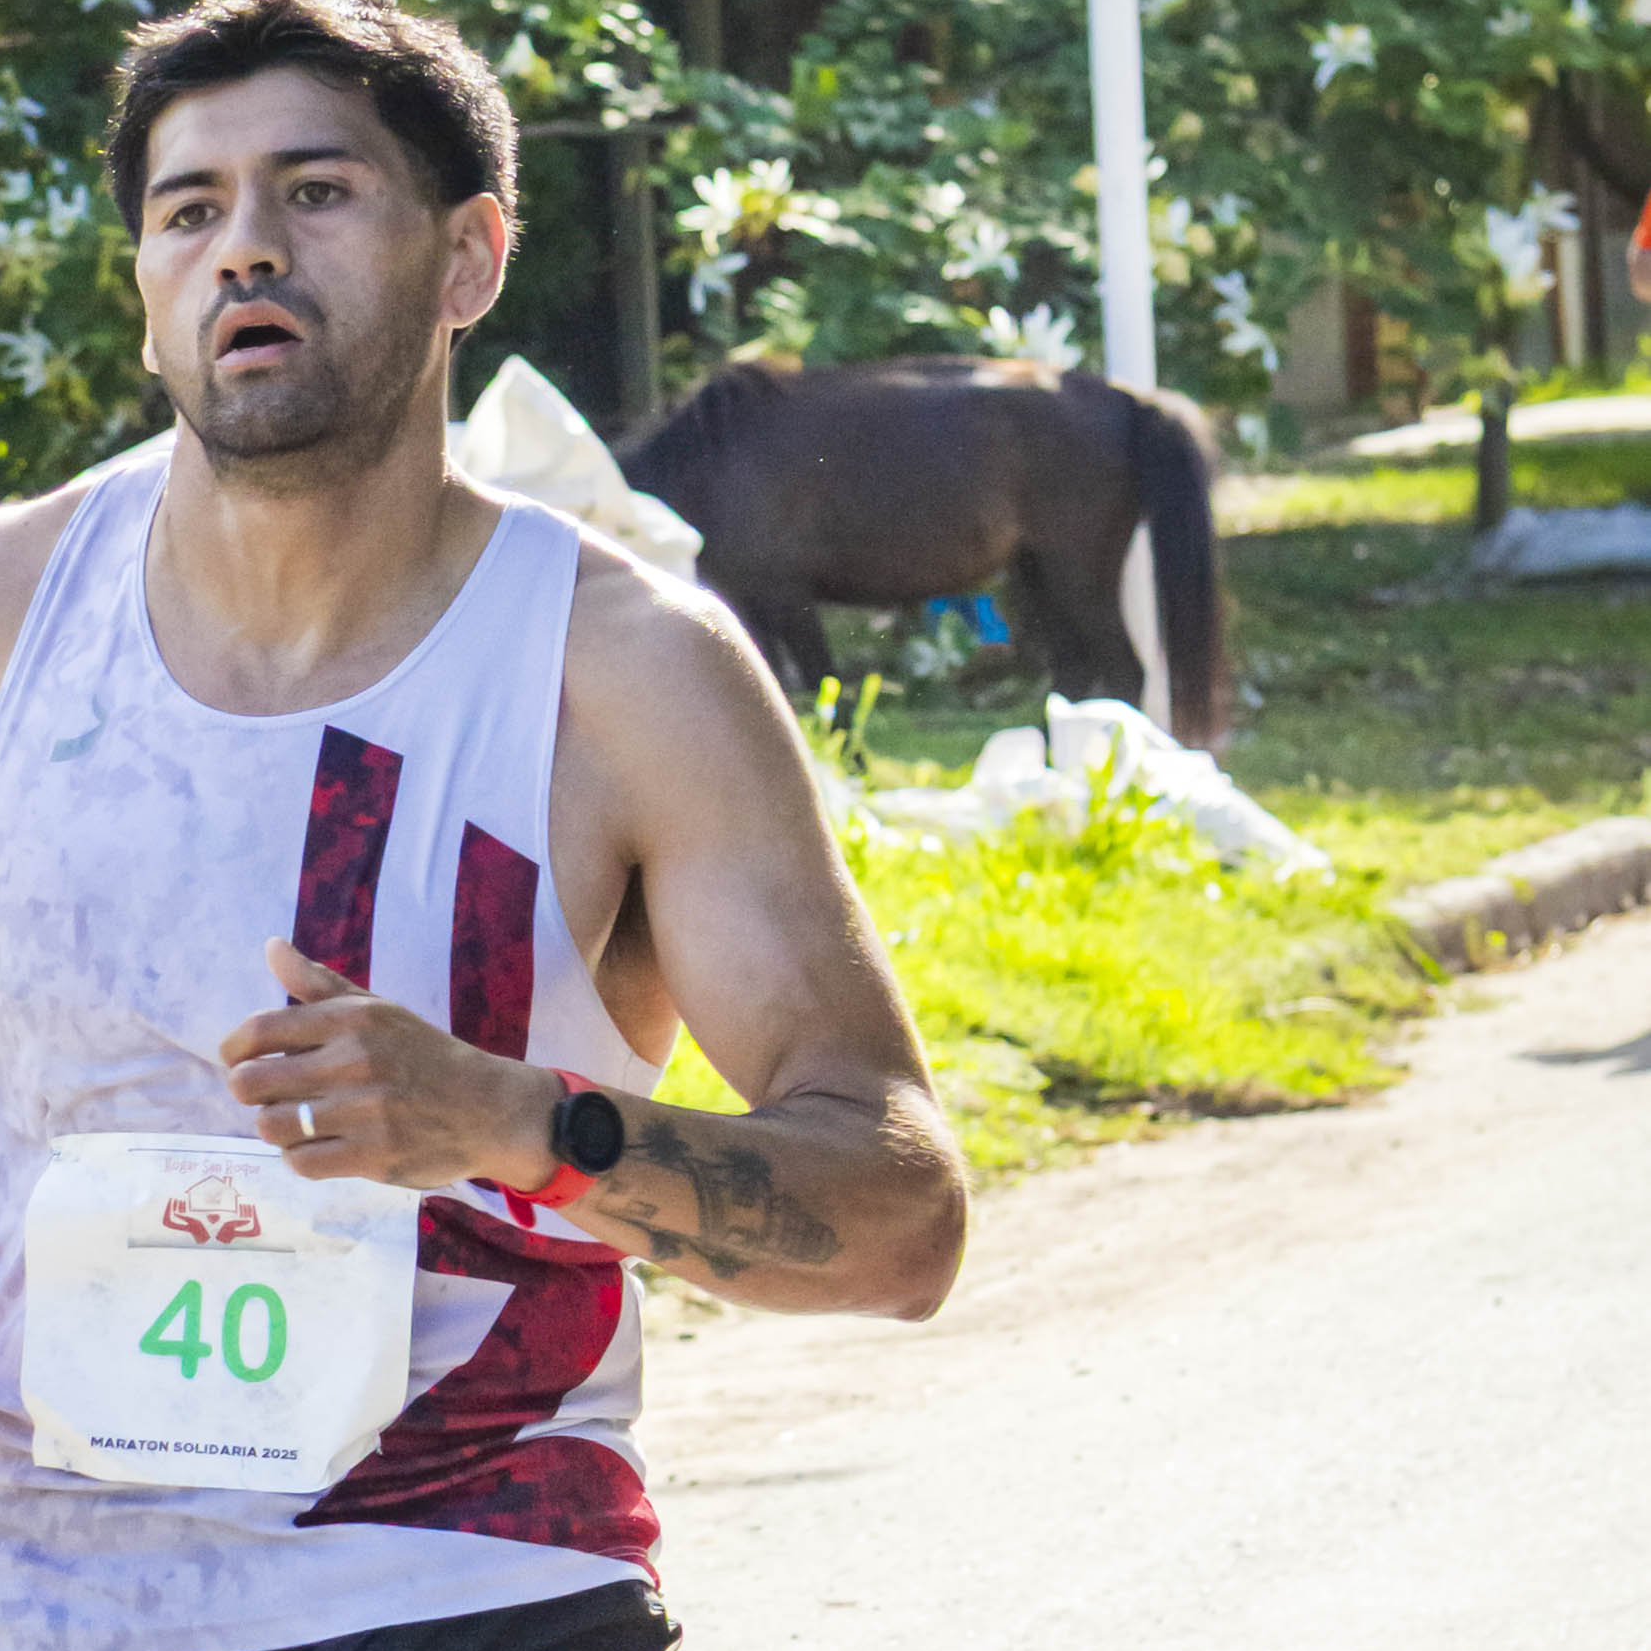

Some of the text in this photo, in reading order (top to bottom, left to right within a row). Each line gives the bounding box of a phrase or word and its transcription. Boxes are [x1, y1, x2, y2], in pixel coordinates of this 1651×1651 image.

[138, 1279, 288, 1383] 40
[90, 1436, 299, 1460] MARATON SOLIDARIA 2025
